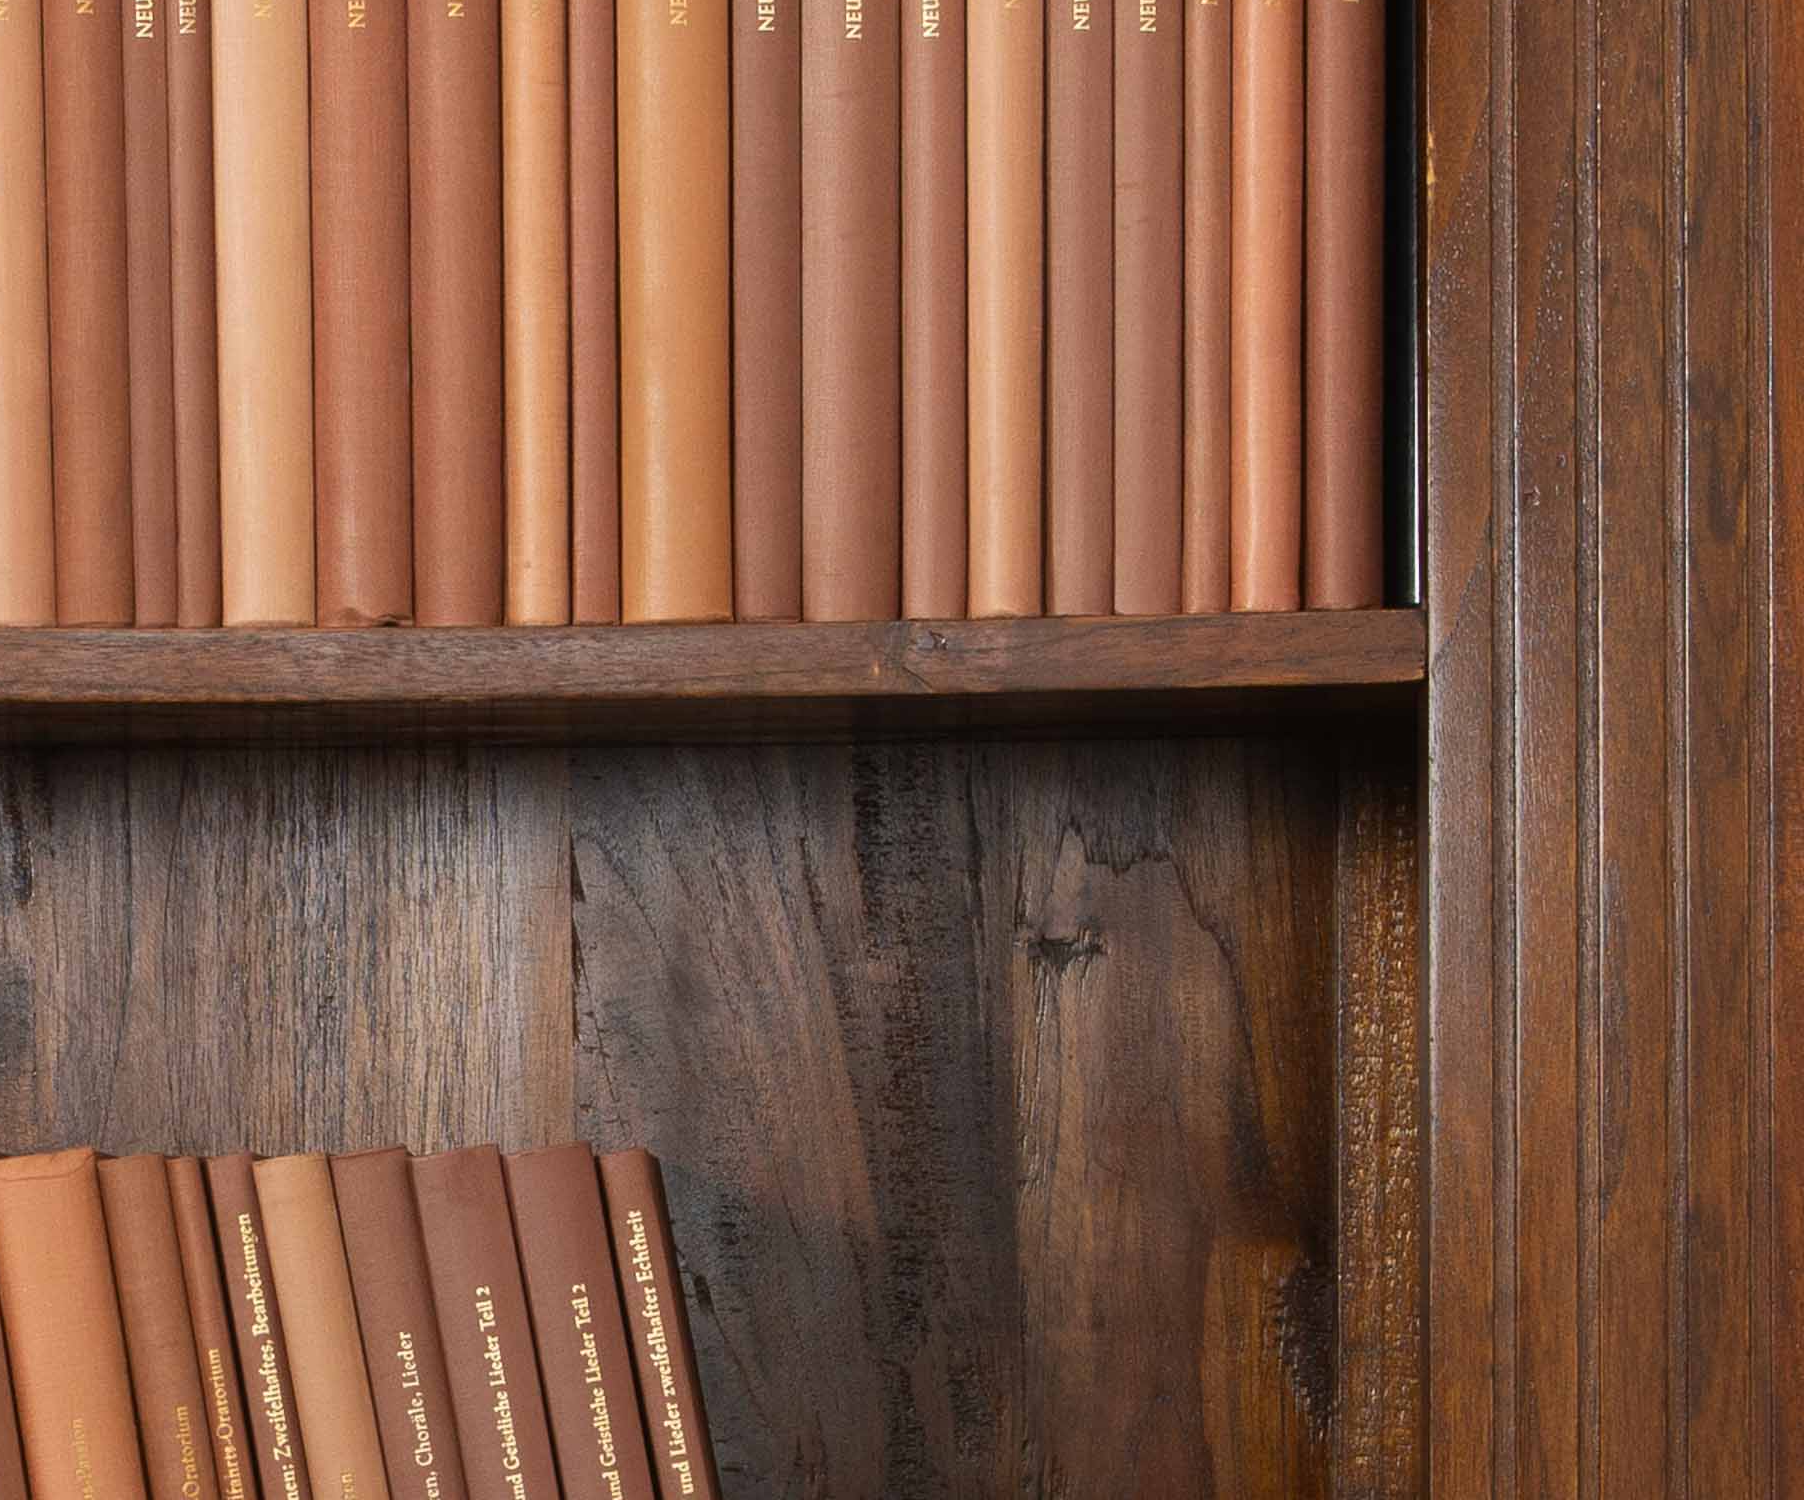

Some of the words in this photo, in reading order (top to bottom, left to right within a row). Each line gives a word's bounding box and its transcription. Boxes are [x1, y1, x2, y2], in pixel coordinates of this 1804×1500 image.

[237, 1212, 272, 1336] Bearbeitungen
[625, 1209, 654, 1282] Echtheit
[475, 1285, 491, 1296] 2
[475, 1299, 496, 1332] Teil
[396, 1330, 420, 1388] Lieder
[483, 1334, 506, 1386] Lieder
[641, 1286, 676, 1397] zweifelhafter
[257, 1338, 292, 1461] Zweifelhaftes,
[406, 1391, 434, 1466] Choräle,
[492, 1390, 520, 1470] Geistliche
[662, 1401, 687, 1456] Lieder
[670, 1459, 694, 1494] und
